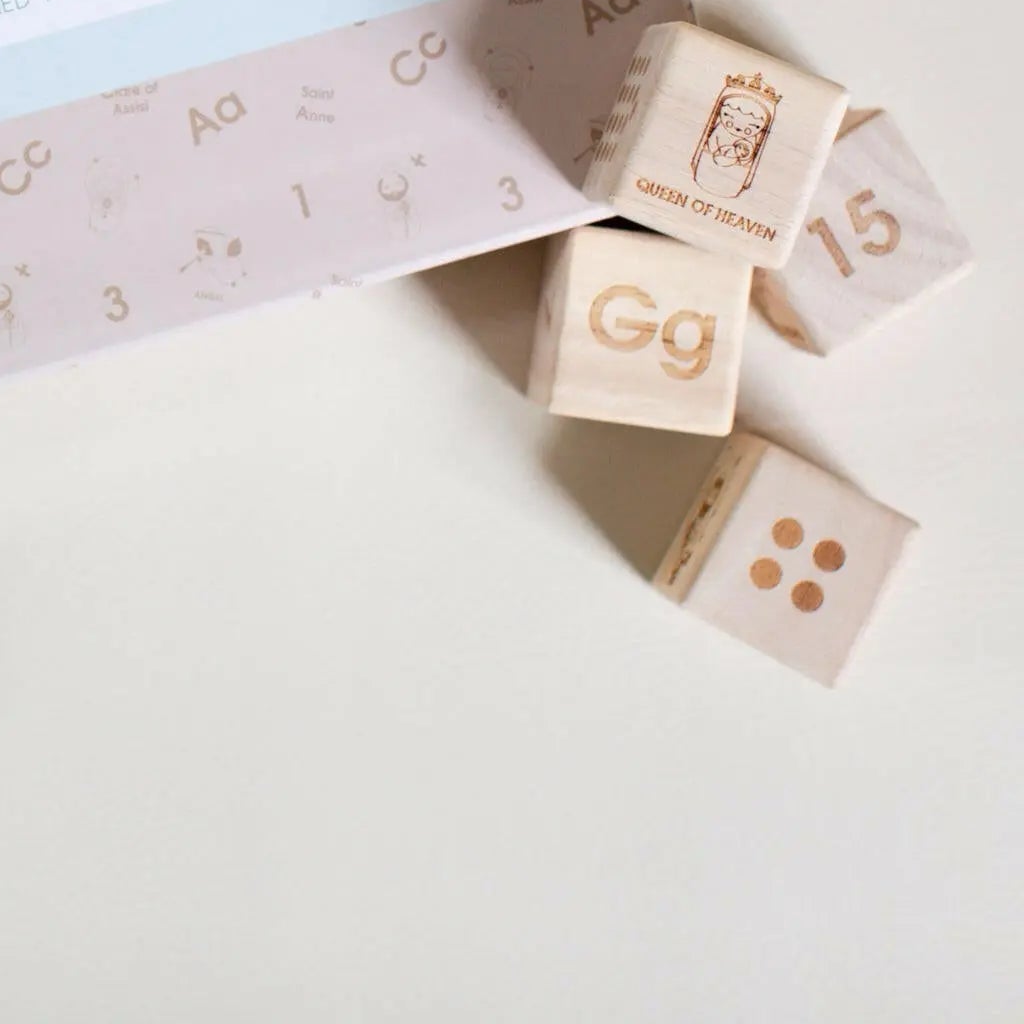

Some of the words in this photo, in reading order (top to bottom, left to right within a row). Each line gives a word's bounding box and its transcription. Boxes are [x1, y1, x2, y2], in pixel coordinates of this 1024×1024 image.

[389, 31, 447, 86] Cc
[296, 106, 335, 124] Anne
[301, 85, 334, 100] Saint
[188, 91, 247, 146] Aa
[291, 183, 311, 219] 1
[498, 176, 524, 212] 3
[636, 178, 689, 208] QUEEN
[691, 199, 714, 216] OF
[714, 207, 777, 242] HEAVEN
[806, 188, 902, 278] 15
[103, 285, 129, 323] 3
[589, 284, 717, 380] Gg
